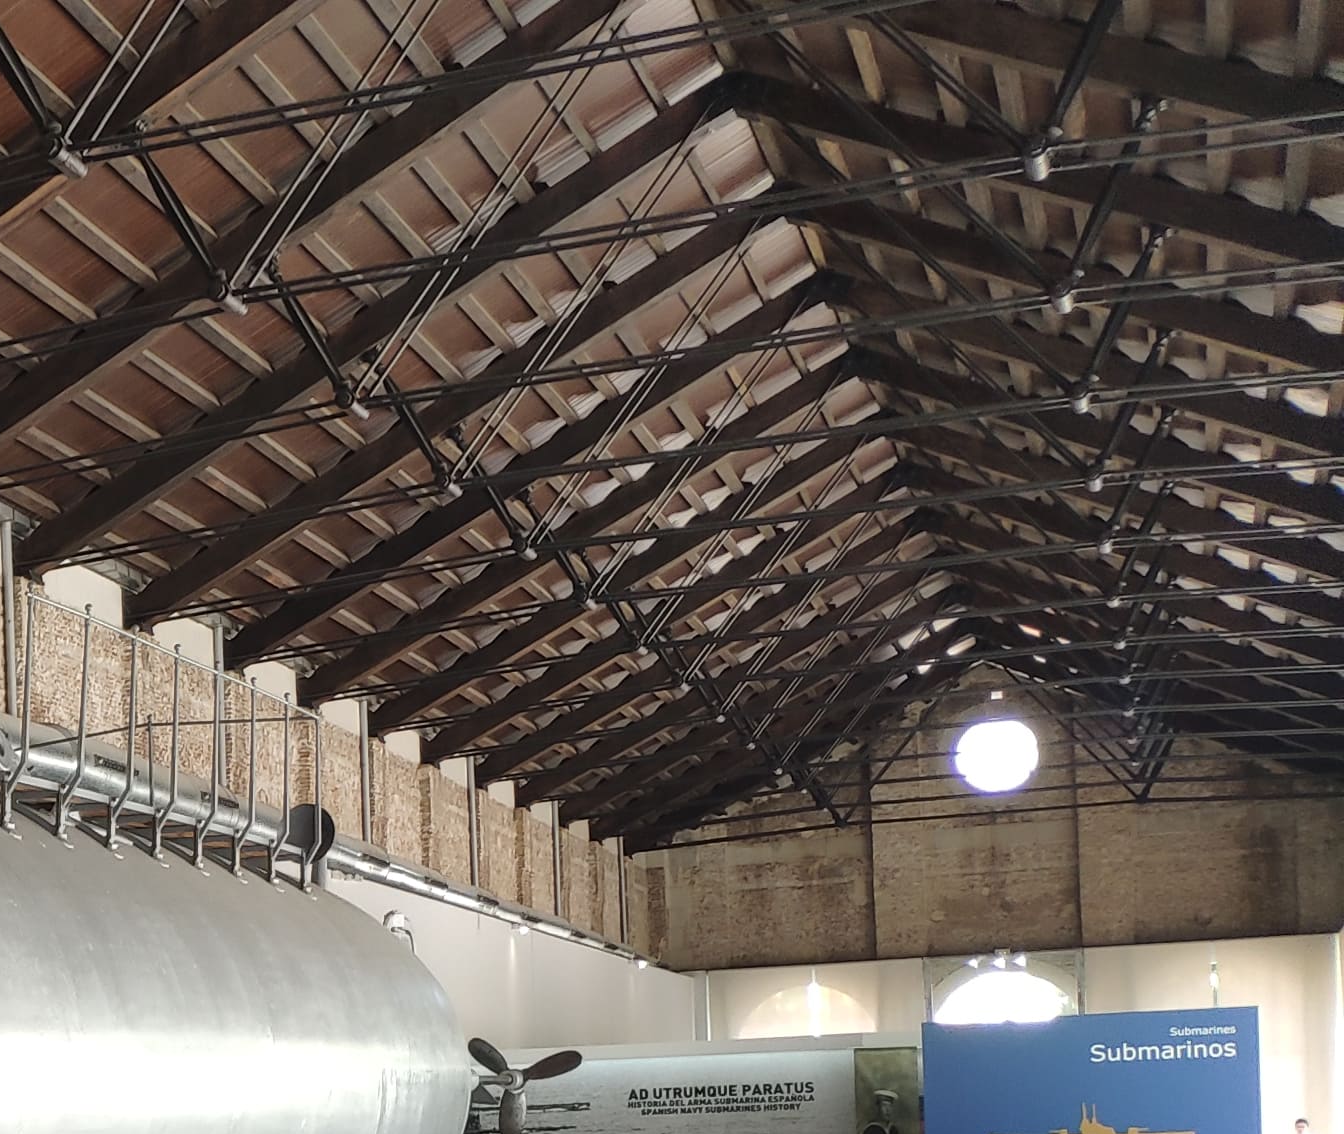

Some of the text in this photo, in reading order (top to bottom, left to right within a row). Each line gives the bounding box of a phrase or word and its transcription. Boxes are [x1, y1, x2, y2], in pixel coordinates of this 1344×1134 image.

[1169, 1025, 1237, 1037] Submarines
[1090, 1040, 1237, 1062] Submarinos
[628, 1081, 815, 1101] AD UTRUMQUE PARATUS
[627, 1101, 667, 1109] HISTORIA
[687, 1098, 712, 1106] ARMA
[714, 1096, 764, 1105] SUBMARINA
[767, 1093, 815, 1103] ESPAÑOLA
[641, 1103, 802, 1116] SPANISH NAVY SUBMARINES HISTORY
